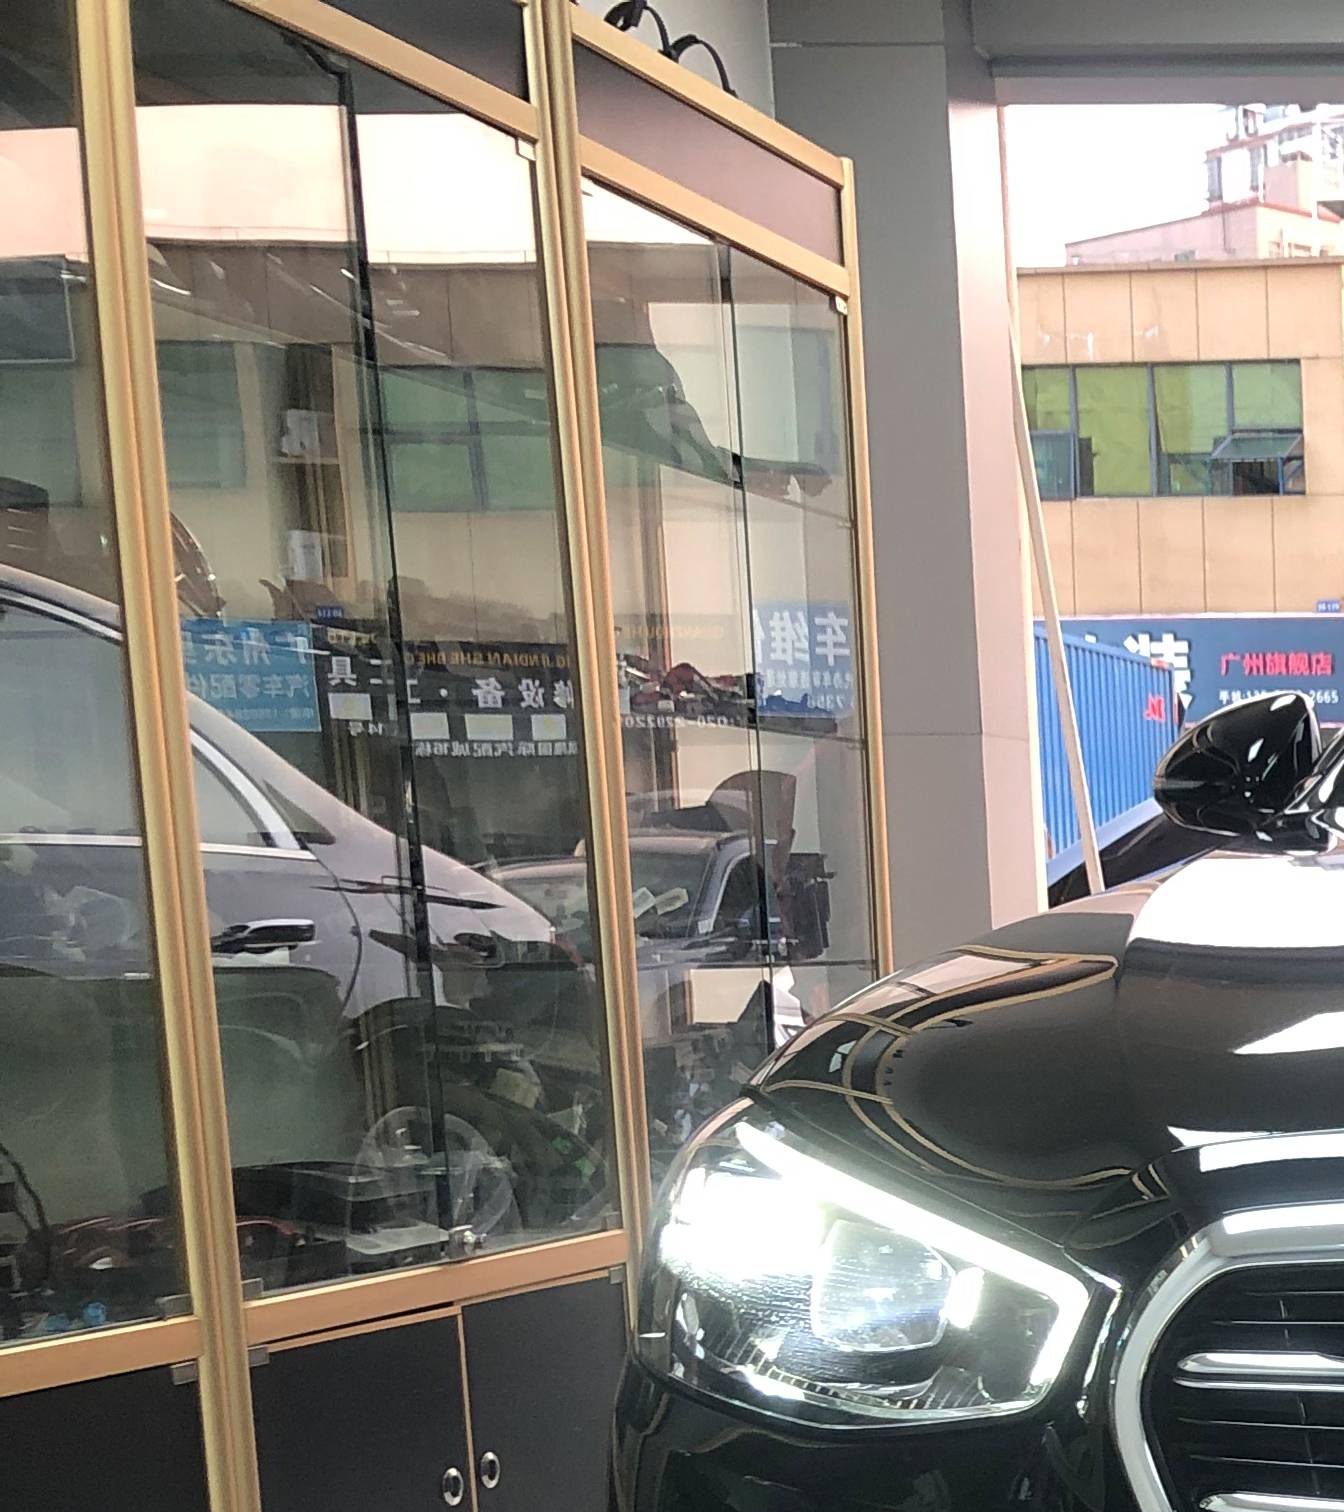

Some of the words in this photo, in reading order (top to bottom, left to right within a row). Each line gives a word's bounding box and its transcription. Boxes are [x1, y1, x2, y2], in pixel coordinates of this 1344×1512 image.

[1220, 651, 1334, 677] 广州旗舰店
